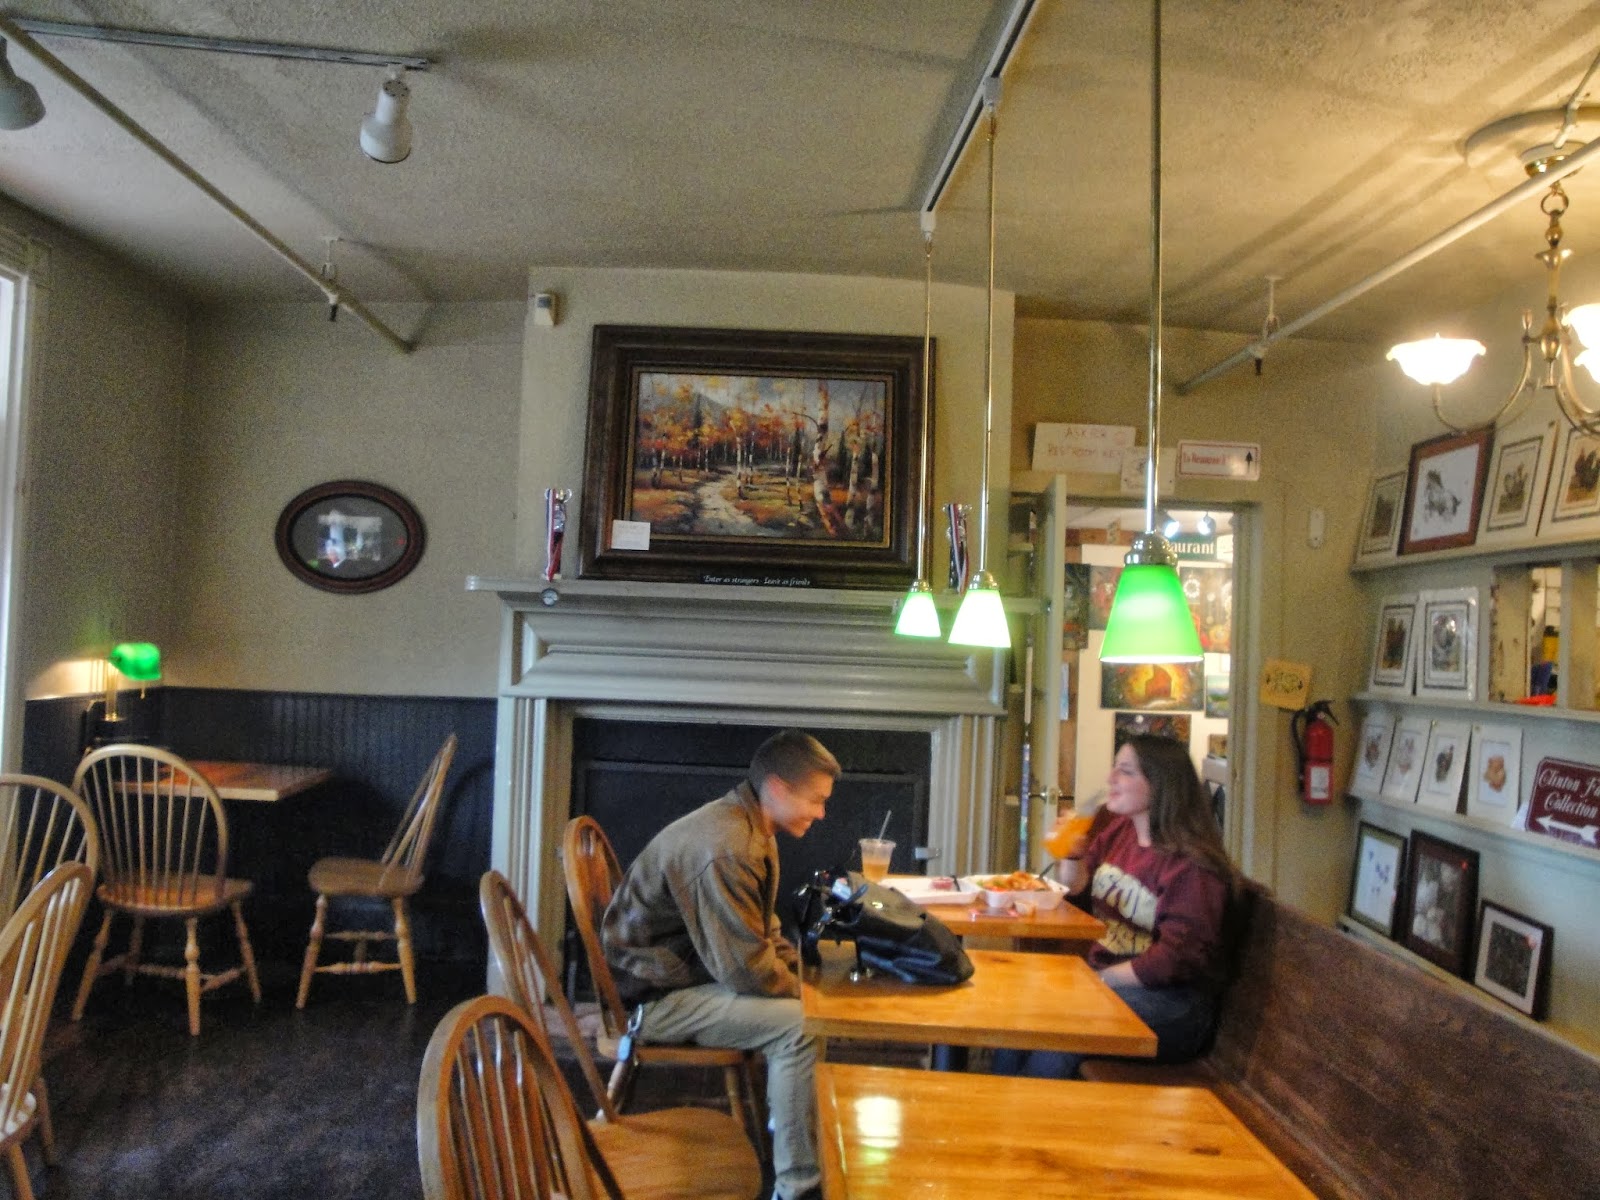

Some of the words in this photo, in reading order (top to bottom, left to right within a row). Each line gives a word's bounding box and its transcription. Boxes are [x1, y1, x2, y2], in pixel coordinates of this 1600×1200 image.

[1171, 541, 1215, 555] aurant
[1539, 769, 1580, 792] Clinton
[1544, 791, 1598, 818] Collection
